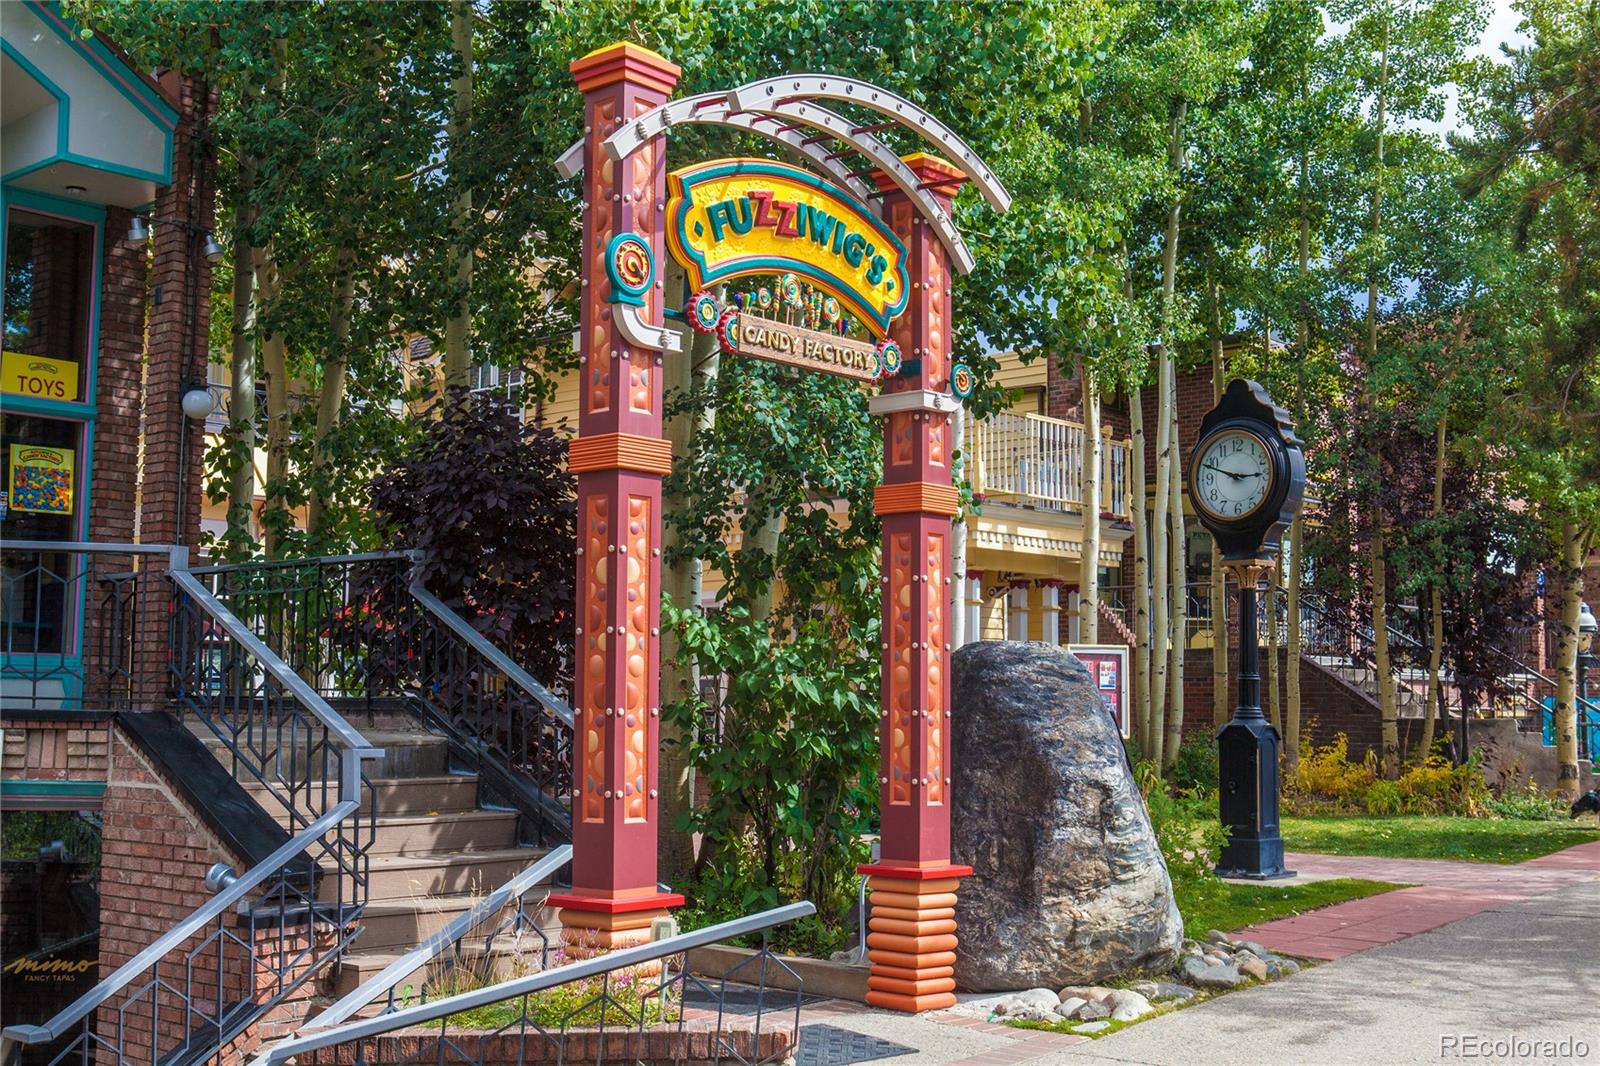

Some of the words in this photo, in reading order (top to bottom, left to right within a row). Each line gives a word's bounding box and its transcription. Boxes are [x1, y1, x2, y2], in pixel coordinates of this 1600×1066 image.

[706, 190, 888, 287] FUZZIWIG'S
[742, 325, 800, 355] CANDY
[803, 338, 873, 371] FACTORY
[17, 375, 65, 397] TOYS
[1219, 443, 1227, 457] 11
[1232, 439, 1244, 452] 12
[1259, 453, 1266, 465] 2
[1206, 473, 1214, 486] 9
[1210, 488, 1218, 501] 8
[1219, 500, 1227, 514] 7
[1234, 503, 1242, 514] 6
[4, 954, 99, 974] mimo
